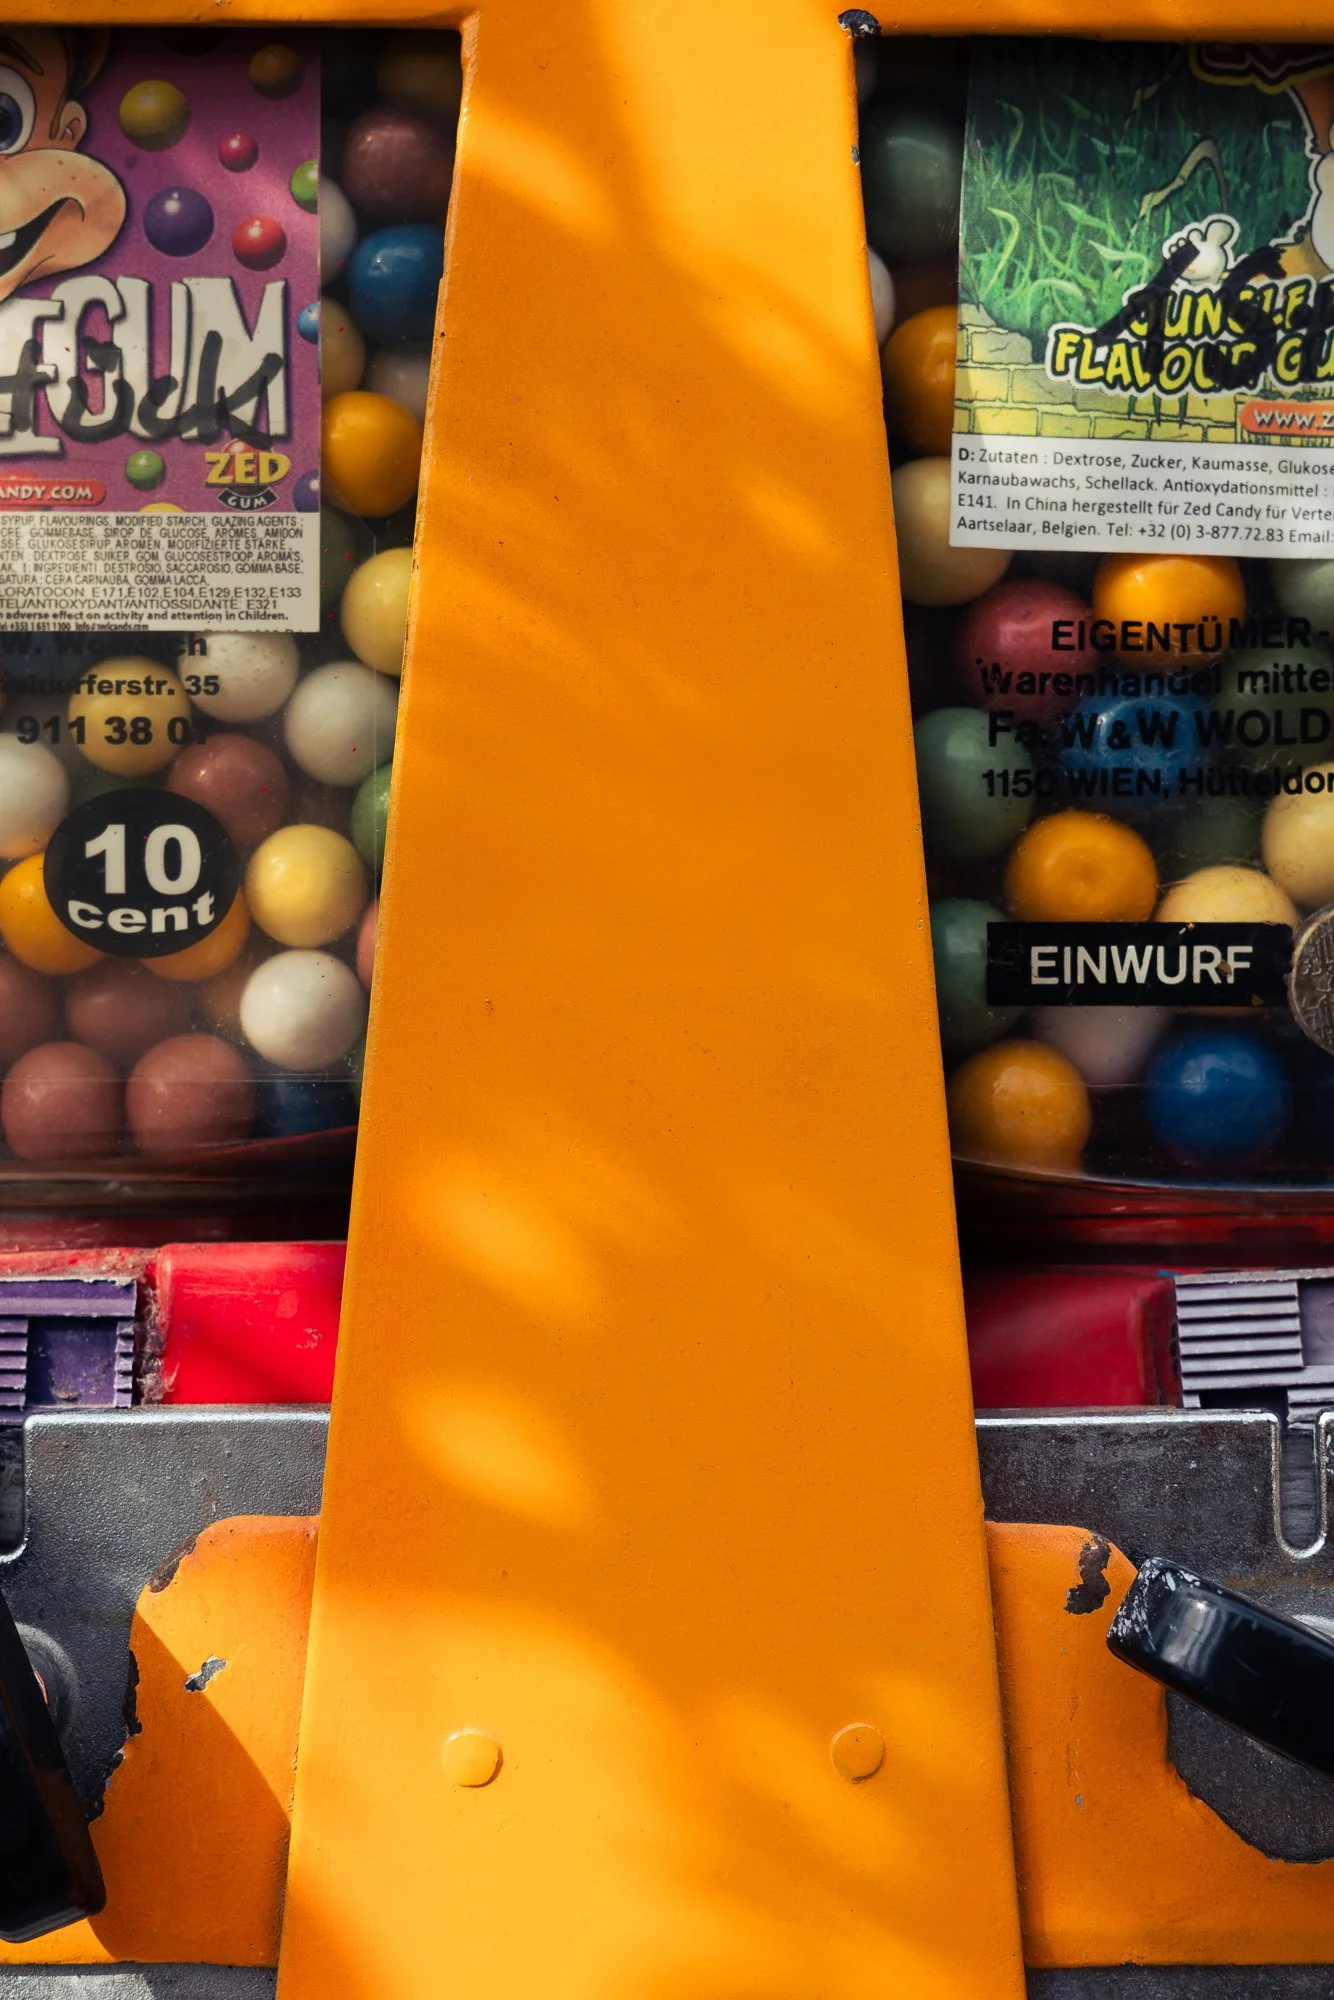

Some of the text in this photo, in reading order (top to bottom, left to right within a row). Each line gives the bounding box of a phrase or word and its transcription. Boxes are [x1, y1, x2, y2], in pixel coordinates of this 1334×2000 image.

[205, 450, 291, 486] ZED
[958, 447, 975, 462] D:
[979, 448, 1038, 465] Zutaten
[1053, 451, 1126, 470] Dextrose,
[1131, 454, 1187, 471] Zucker,
[1192, 456, 1272, 474] Kaumasse,
[1277, 459, 1334, 476] Glukose
[958, 470, 1080, 491] Karnaubawachs,
[1085, 475, 1158, 491] Schellack.
[1163, 478, 1318, 498] Antioxydationsmittel
[226, 494, 268, 508] GUM
[957, 493, 997, 510] E141.
[1006, 496, 1020, 511] In
[1025, 497, 1067, 513] China
[1072, 498, 1152, 517] hergestellt
[1158, 500, 1180, 516] für
[1184, 501, 1211, 517] Zed
[1216, 503, 1262, 521] Candy
[1266, 504, 1287, 520] für
[104, 527, 134, 539] SIROP
[140, 527, 152, 539] DE
[265, 528, 303, 539] AMIDON
[116, 515, 162, 527] MODIFIED
[212, 515, 255, 527] GLAZING
[956, 516, 1037, 536] Aartselaar,
[1042, 520, 1101, 539] Belgien.
[1106, 522, 1133, 537] Tel:
[1138, 523, 1166, 538] +32
[1170, 524, 1191, 541] (0)
[1195, 525, 1285, 542] 3-877.72.83
[6, 610, 289, 622] adverse effect on activity and attention in Children.
[247, 599, 277, 610] E321
[185, 675, 220, 696] 35
[1238, 663, 1334, 693] mitte
[17, 715, 86, 744] 911
[104, 716, 153, 745] 38
[982, 769, 1055, 798] 1150
[1067, 767, 1170, 800] WIEN,
[84, 823, 202, 895] 10
[67, 890, 216, 934] cent
[1030, 944, 1254, 986] EINWURF
